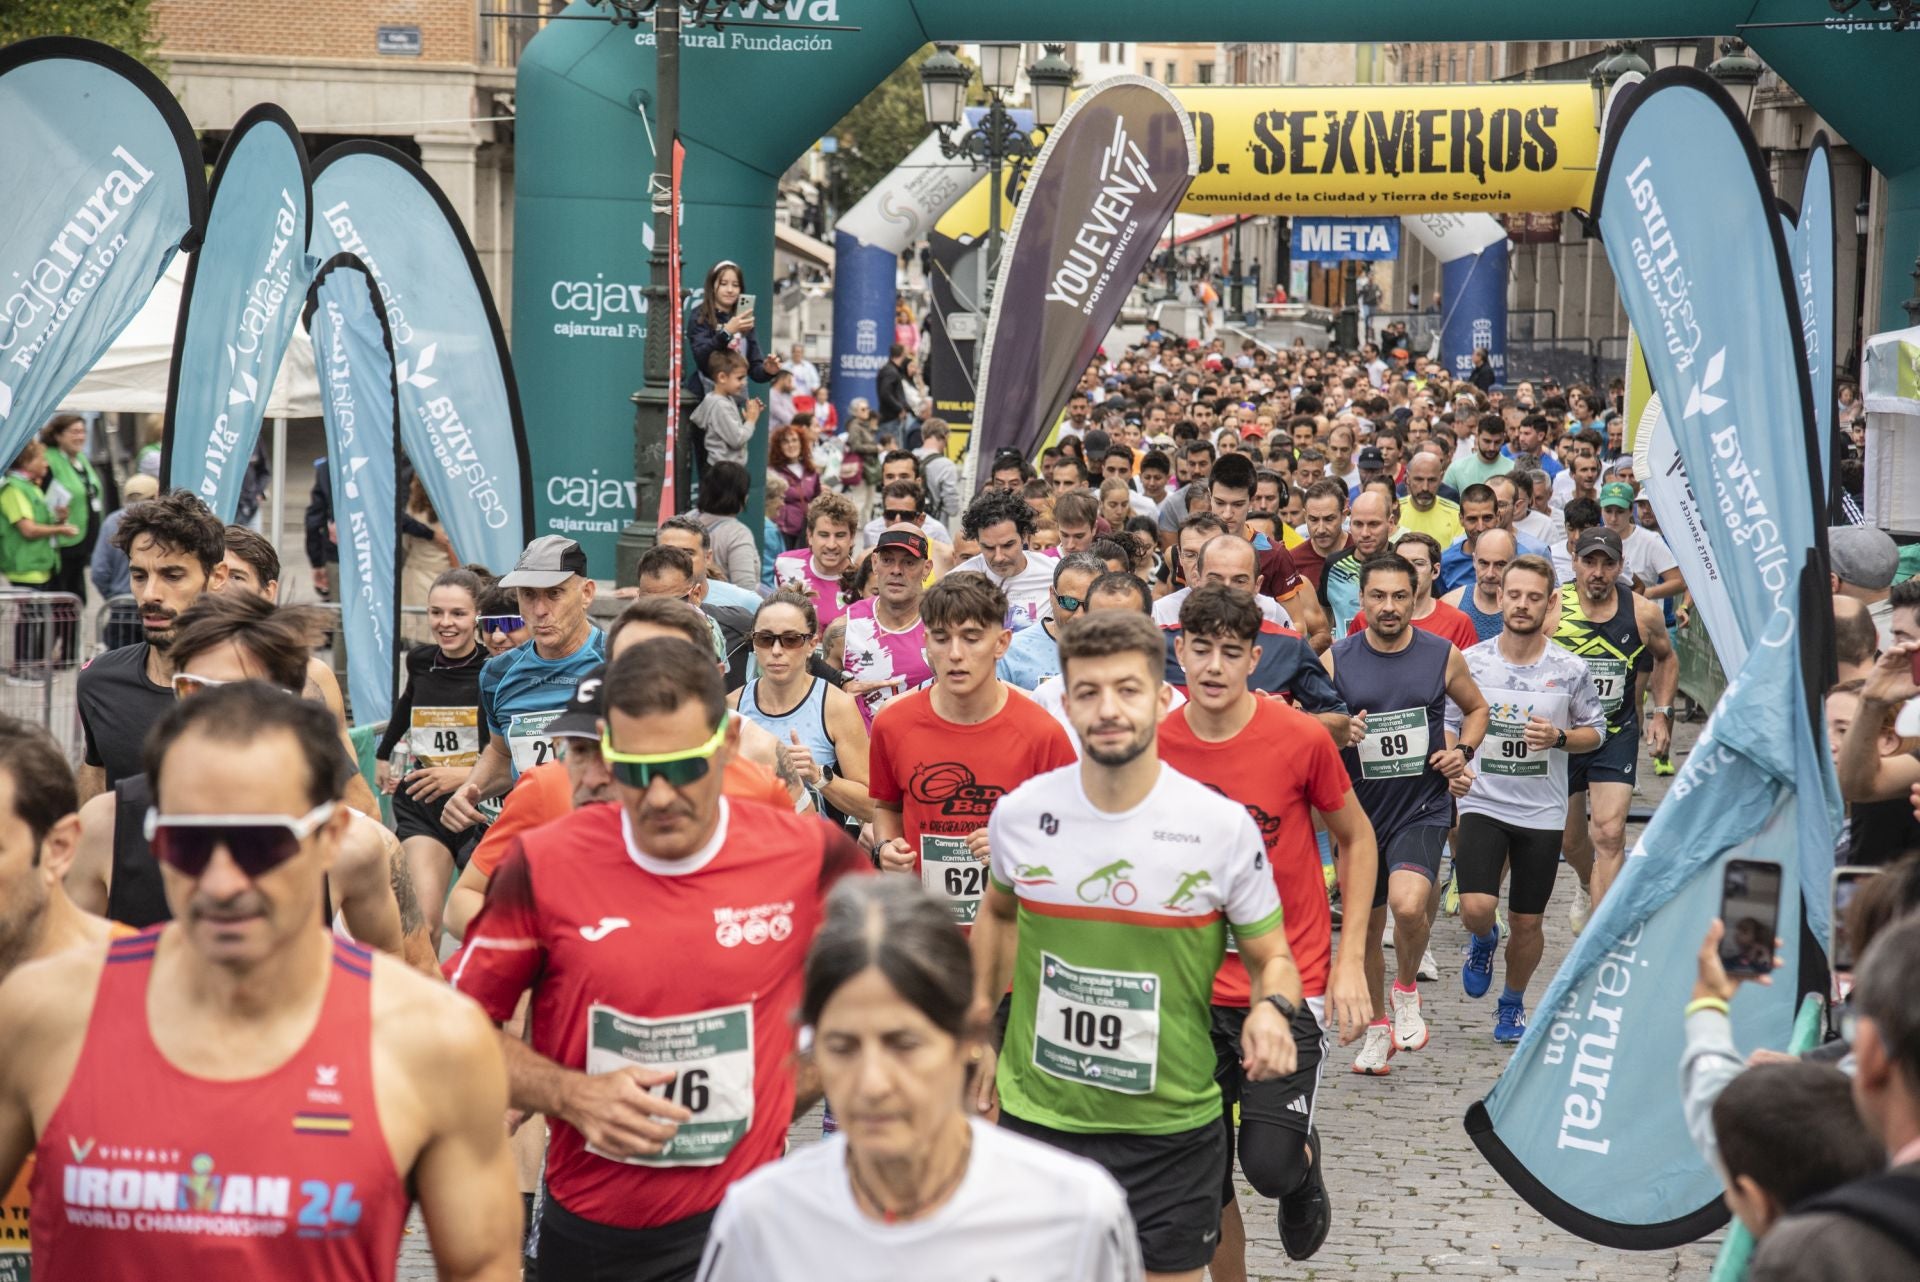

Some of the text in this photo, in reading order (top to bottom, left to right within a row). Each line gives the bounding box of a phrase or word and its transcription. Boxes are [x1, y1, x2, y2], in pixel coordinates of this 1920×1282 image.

[731, 33, 833, 51] Fundación
[1248, 106, 1559, 184] SEXMEROS
[1186, 190, 1512, 203] Comunidad de la Ciudad y Tierra de Segovia
[1301, 225, 1392, 252] META
[1045, 249, 1099, 308] YOU
[1082, 219, 1139, 316] SPORTS SERVICES
[553, 321, 624, 338] cajarural
[548, 515, 619, 533] cajarural
[434, 731, 459, 752] 48
[1380, 734, 1408, 757] 89
[1502, 740, 1528, 759] 90
[1152, 830, 1202, 845] SEGOVIA
[1059, 1006, 1122, 1051] 109
[63, 1154, 291, 1217] IRONMAN
[64, 1206, 287, 1239] WORLD CHAMPIONSHIP
